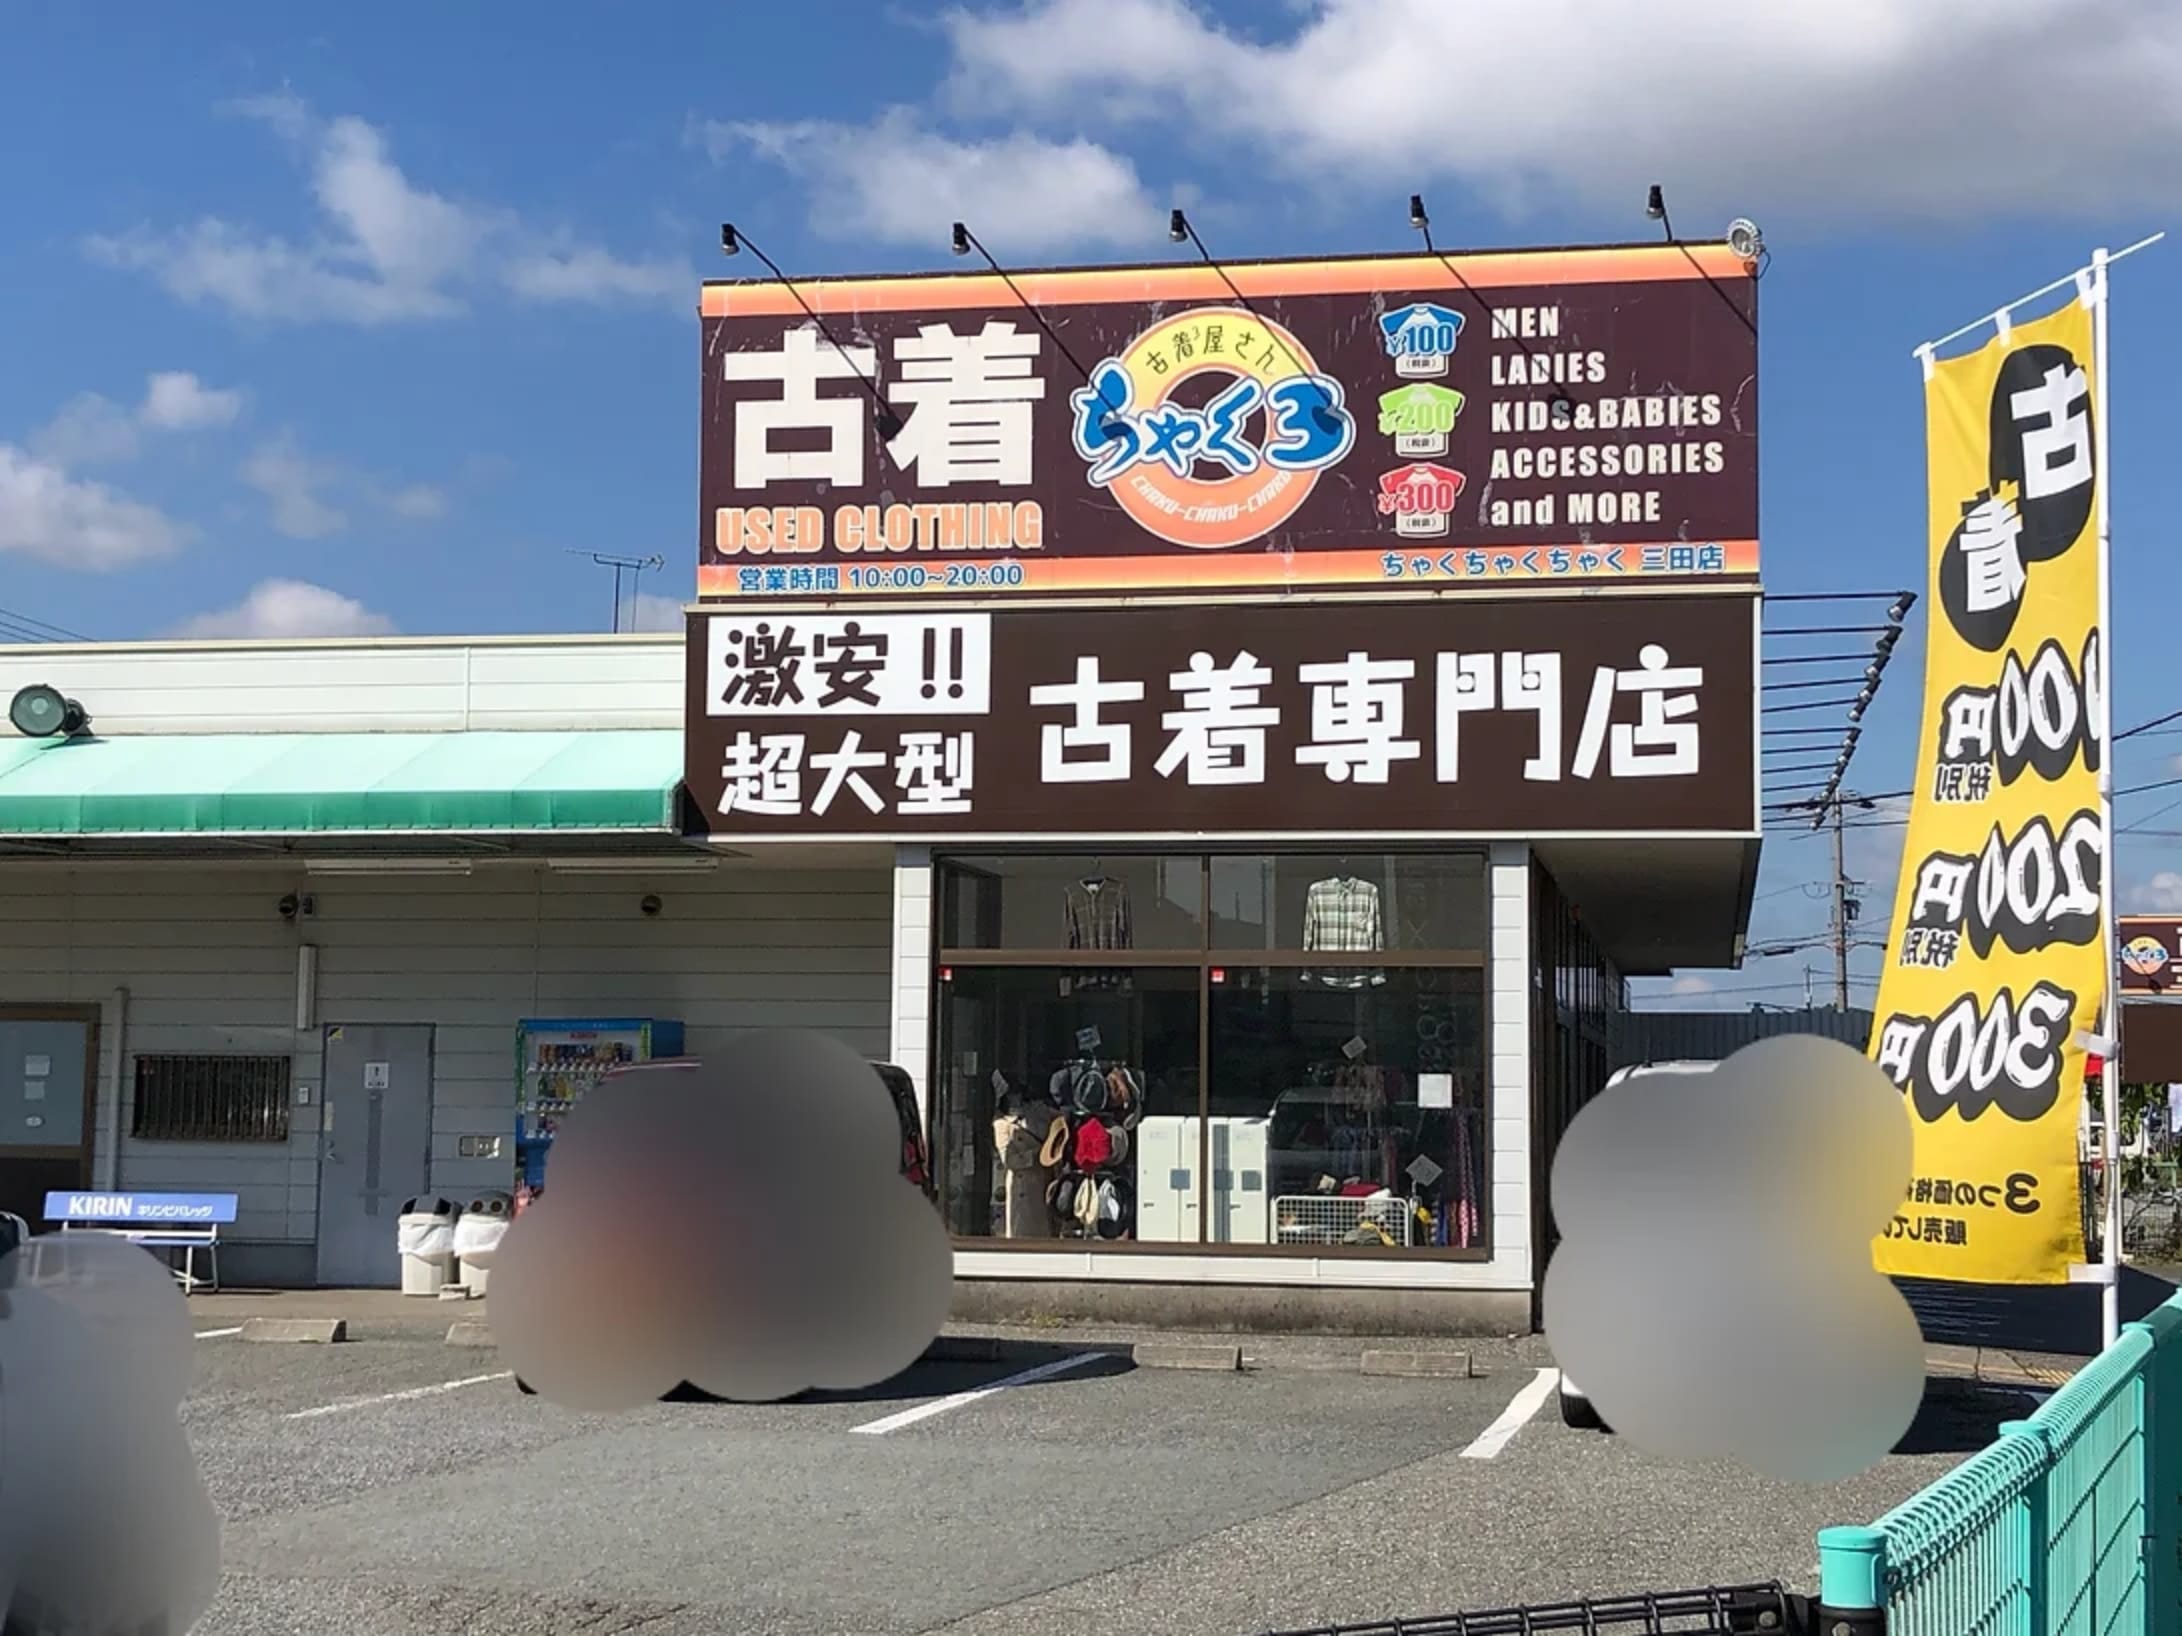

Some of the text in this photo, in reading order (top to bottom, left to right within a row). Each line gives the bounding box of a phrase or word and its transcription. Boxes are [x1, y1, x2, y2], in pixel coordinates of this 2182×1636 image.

[1491, 306, 1560, 339] MEN
[1491, 352, 1606, 386] LADIES
[725, 322, 1045, 489] 古着
[1491, 395, 1721, 433] KIDS&BABIES
[1491, 442, 1724, 479] ACCESSORIES
[1379, 482, 1454, 516] ¥300
[1491, 491, 1661, 526] and MORE
[716, 500, 1043, 555] USED CLOTHING
[1382, 545, 1724, 577] ちゃくちゃくちゃく 三田店
[738, 567, 839, 591] 営業時間
[1029, 644, 1703, 785] 古着専門店
[717, 730, 974, 816] 超大型
[69, 1195, 133, 1217] KIRIN
